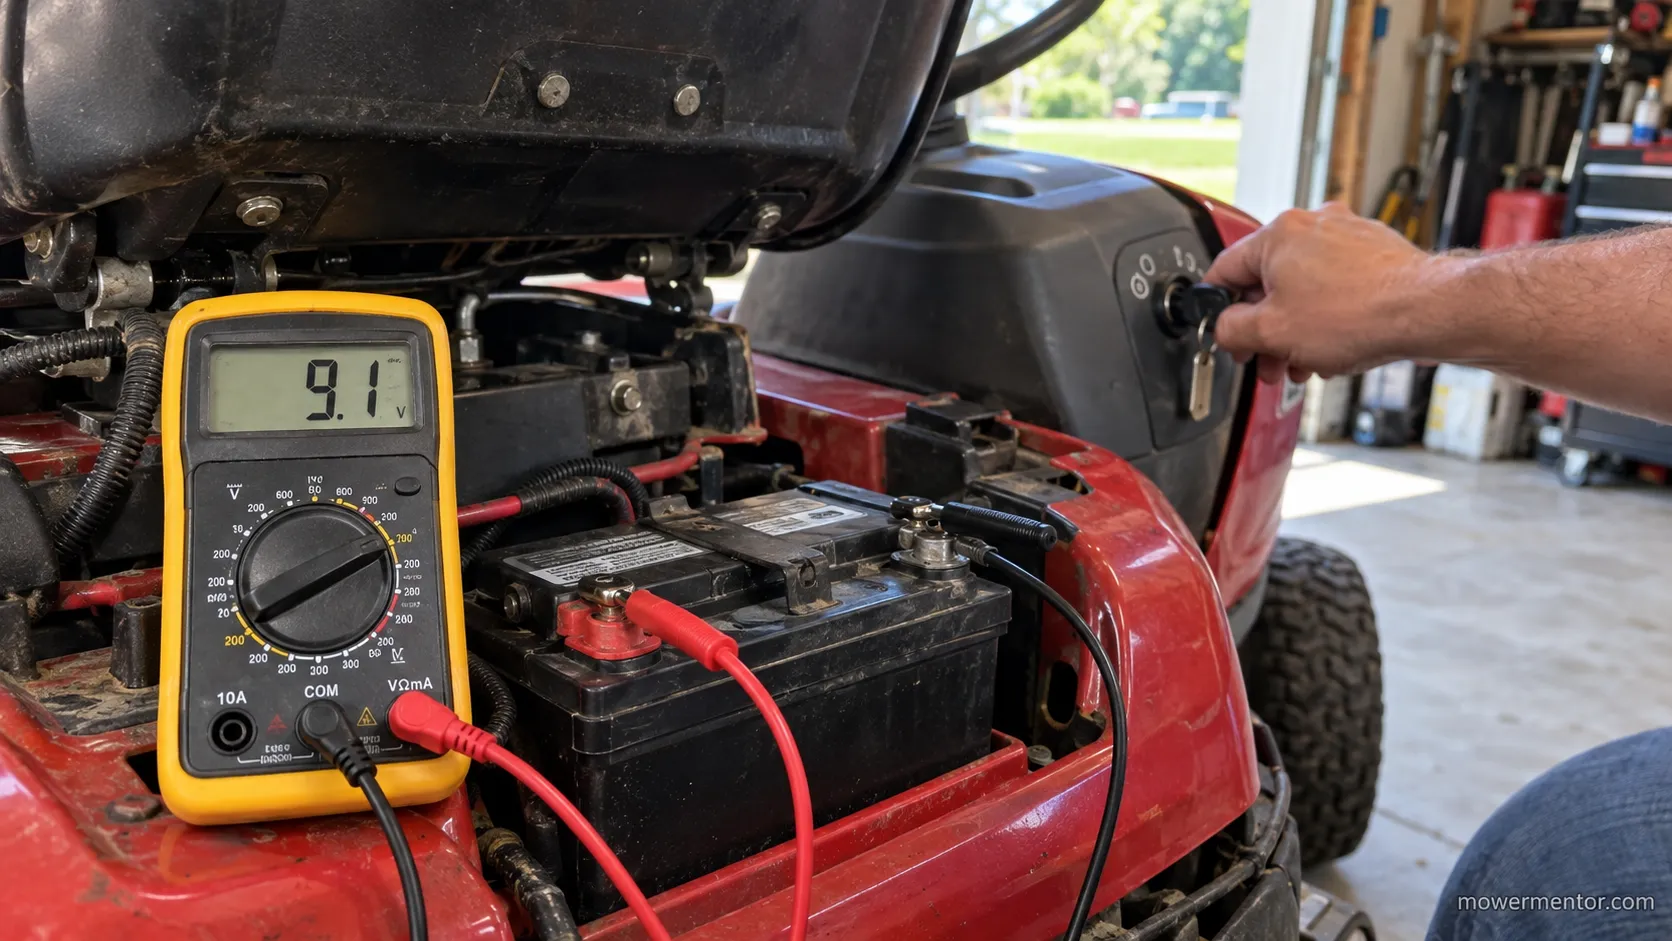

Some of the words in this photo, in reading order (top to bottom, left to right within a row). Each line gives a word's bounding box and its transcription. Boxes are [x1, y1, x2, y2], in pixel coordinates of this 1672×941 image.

[306, 359, 379, 421] 9.1
[396, 406, 406, 419] V
[275, 490, 293, 499] 600
[247, 503, 265, 513] 200
[213, 549, 231, 559] 200
[404, 559, 420, 568] 200
[207, 576, 226, 588] 200
[404, 587, 420, 597] 200
[217, 608, 230, 618] 20
[395, 614, 413, 624] 200
[224, 635, 245, 646] 200
[249, 653, 268, 664] 200
[277, 664, 297, 674] 200
[342, 659, 360, 669] 300
[310, 665, 329, 676] 300
[388, 677, 433, 692] VΩmA
[304, 684, 339, 698] COM
[217, 691, 247, 705] 10A
